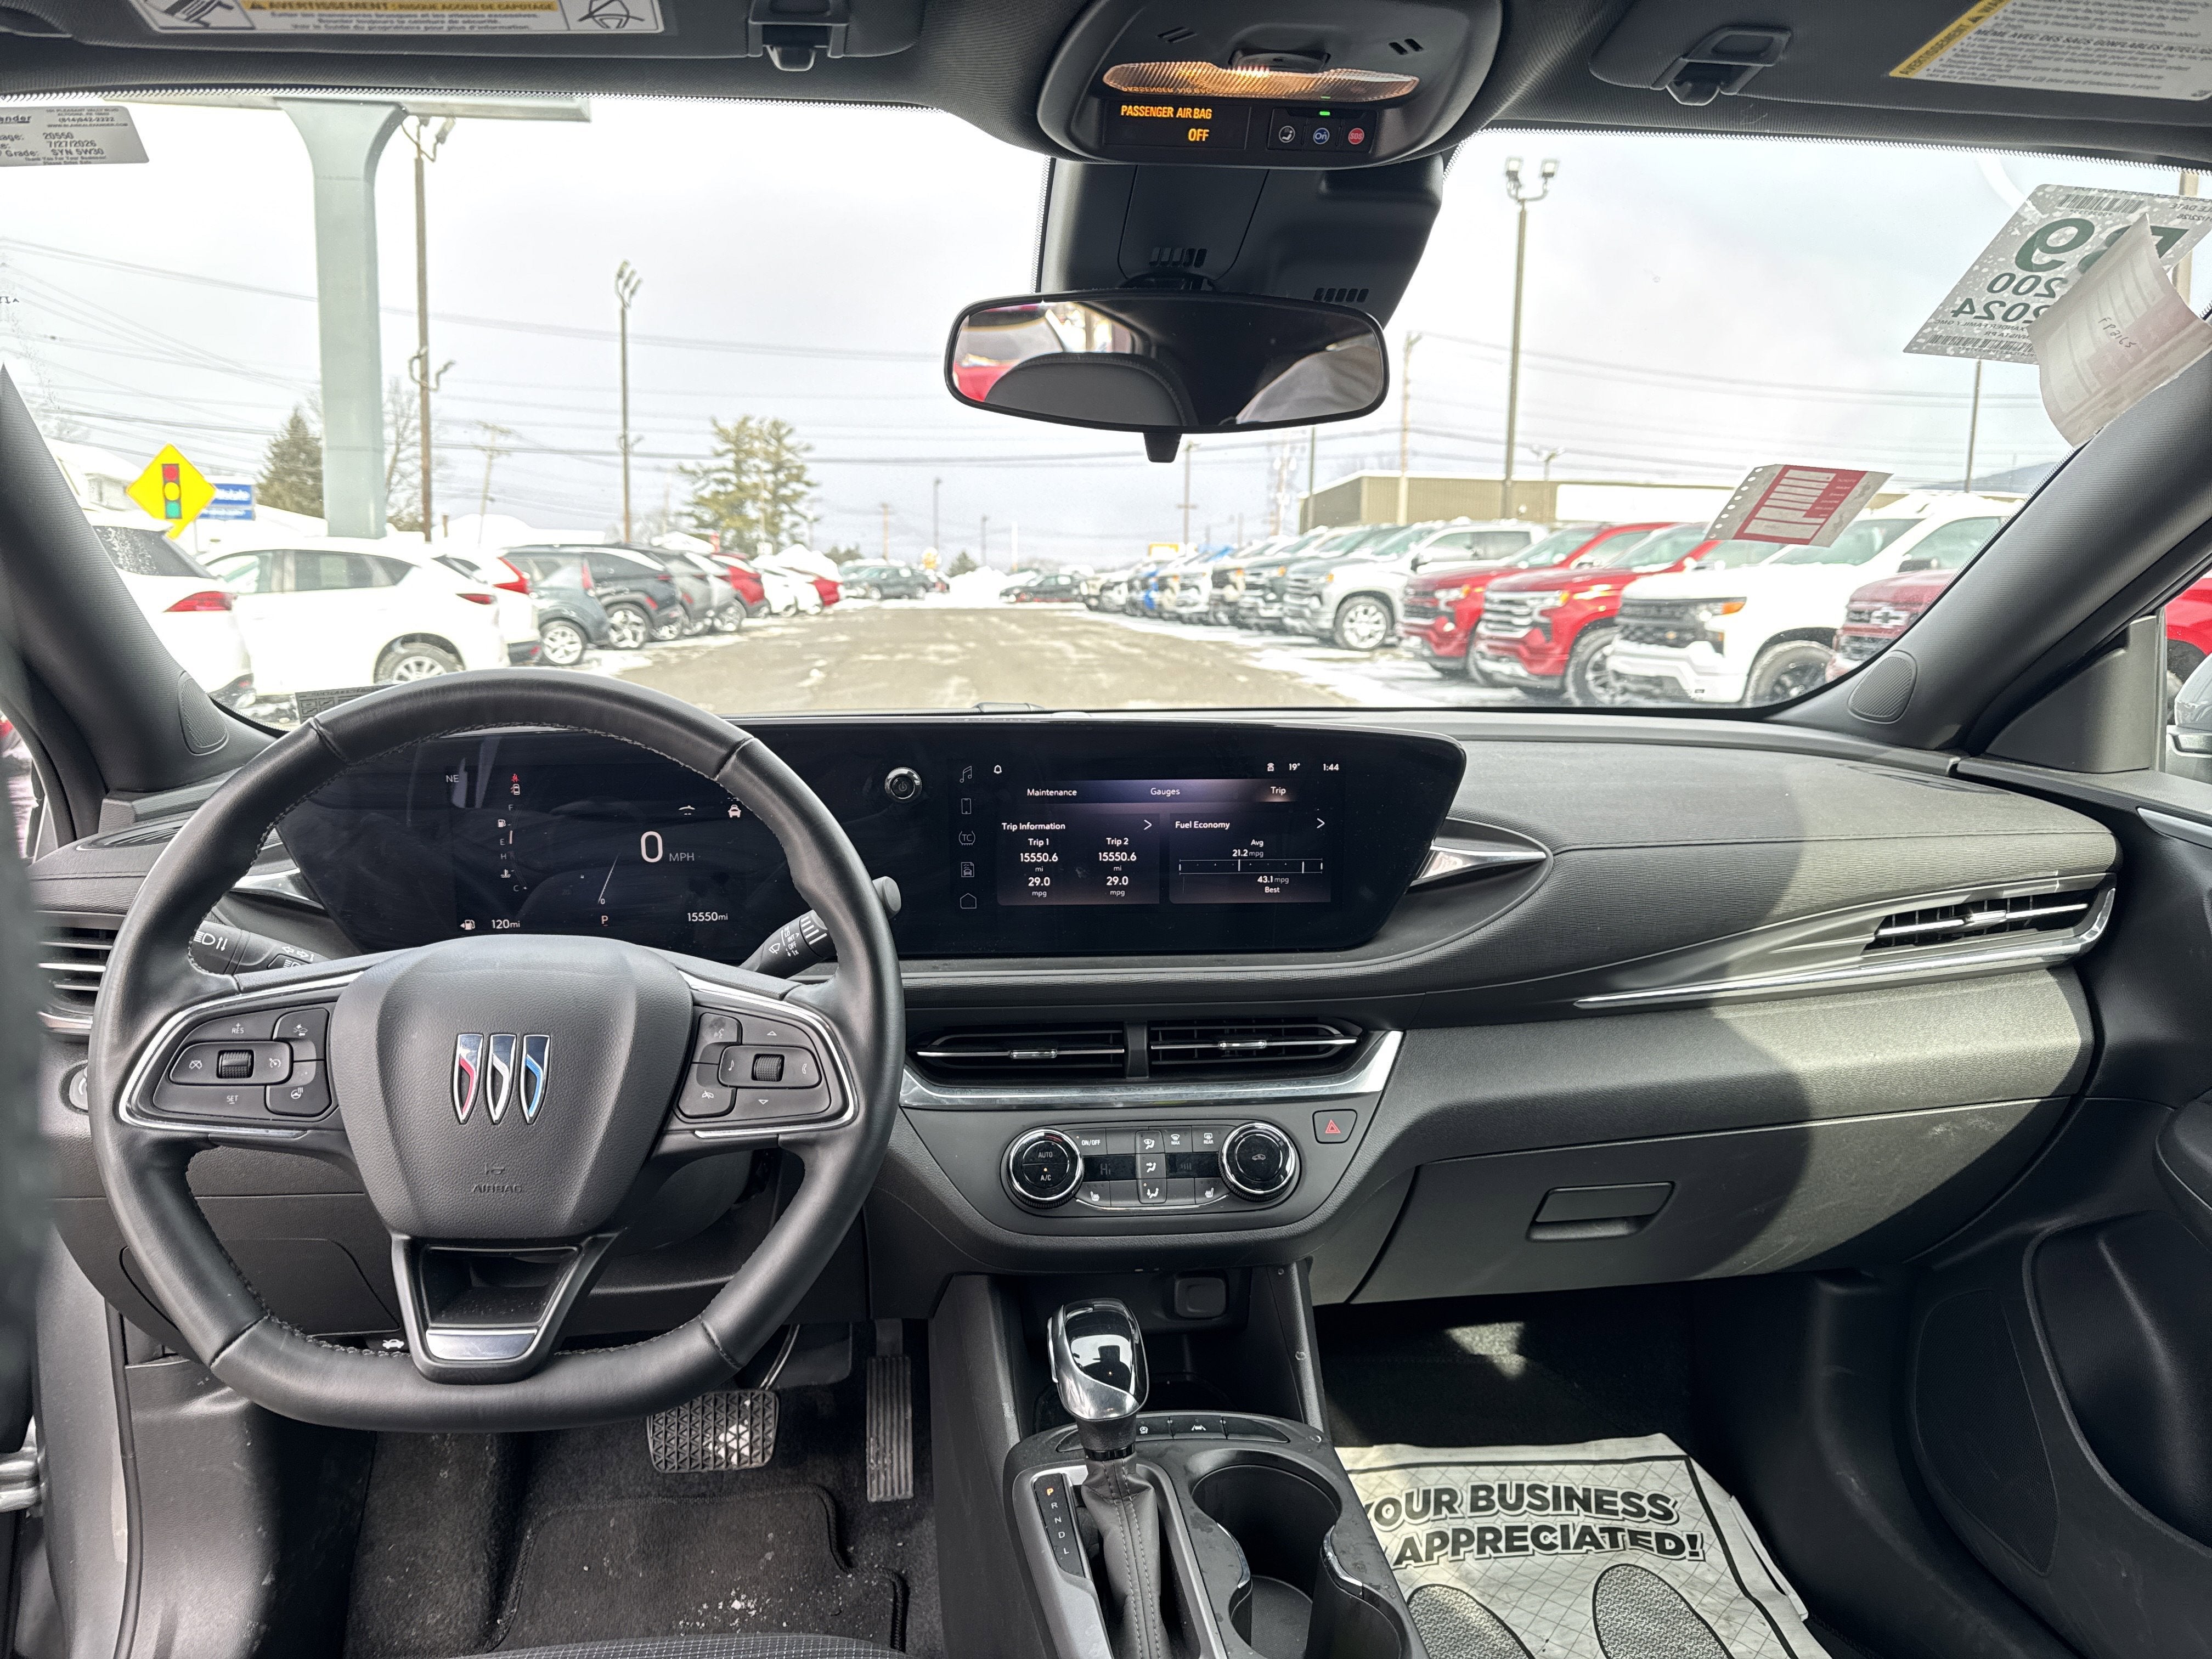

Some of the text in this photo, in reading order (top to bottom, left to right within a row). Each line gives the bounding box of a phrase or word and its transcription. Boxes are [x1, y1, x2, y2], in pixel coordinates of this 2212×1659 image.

[1121, 105, 1212, 120] PASSENGER AIR BAG
[1188, 128, 1210, 141] OFF
[1150, 788, 1180, 797] Gauges
[1271, 787, 1286, 796] Trip
[1002, 823, 1018, 831] Trip
[1194, 821, 1230, 830] Economy
[640, 831, 695, 862] 0 MPH
[1028, 838, 1044, 847] Trip
[1106, 838, 1122, 846] Trip
[1020, 853, 1058, 862] 15550.6
[1098, 852, 1137, 861] 15550.6
[1028, 877, 1050, 886] 29.0
[1107, 877, 1128, 885] 29.0
[601, 915, 608, 924] P
[472, 1184, 523, 1193] AIRBAG
[1047, 1488, 1054, 1496] P
[1364, 1483, 1674, 1527] OUR BUSINESS
[1393, 1524, 1700, 1566] APPRECIATED!
